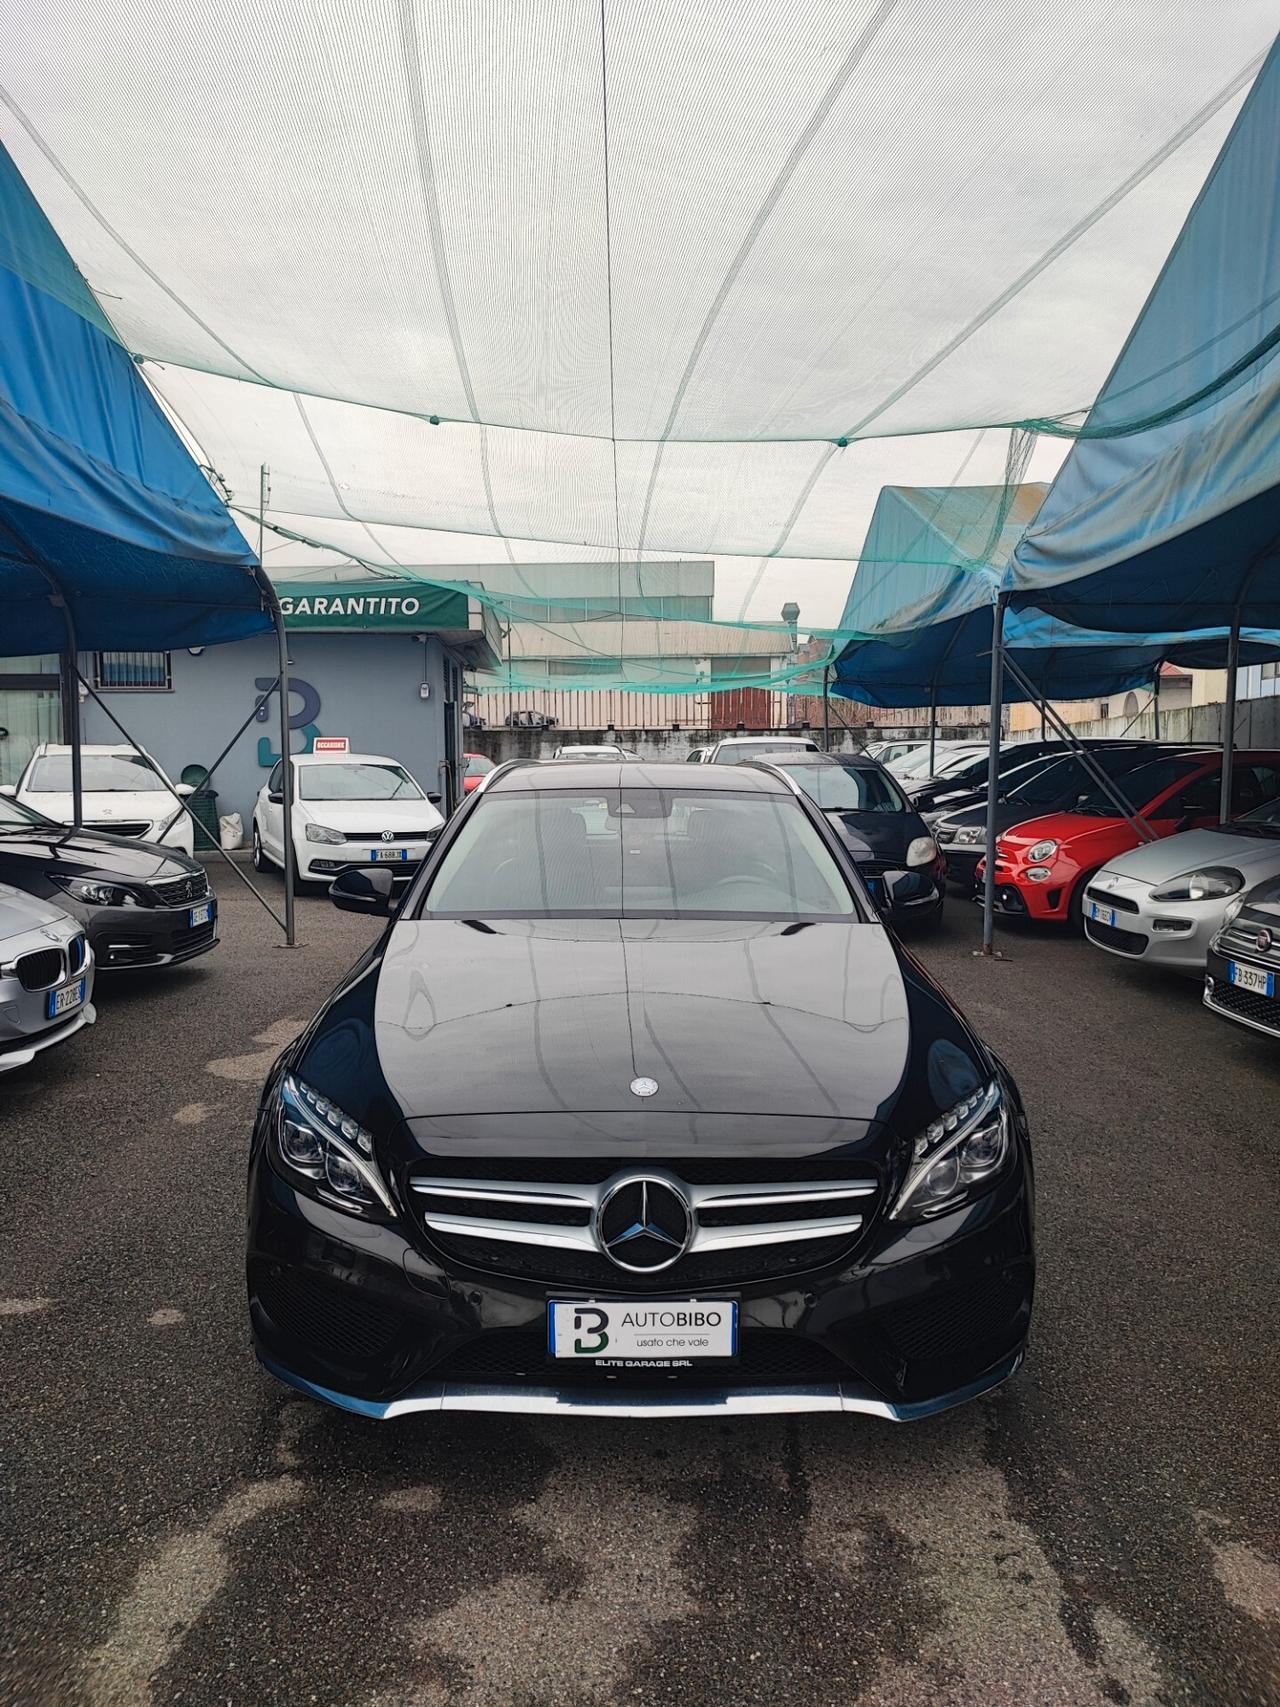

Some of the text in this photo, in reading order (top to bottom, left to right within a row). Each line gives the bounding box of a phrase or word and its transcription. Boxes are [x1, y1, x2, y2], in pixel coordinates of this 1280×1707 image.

[280, 597, 420, 615] GARANTITO
[621, 1312, 721, 1327] AUTOBIBO
[636, 1338, 709, 1347] usato che vale
[595, 1359, 624, 1367] ELITE
[625, 1359, 670, 1368] GARAGE
